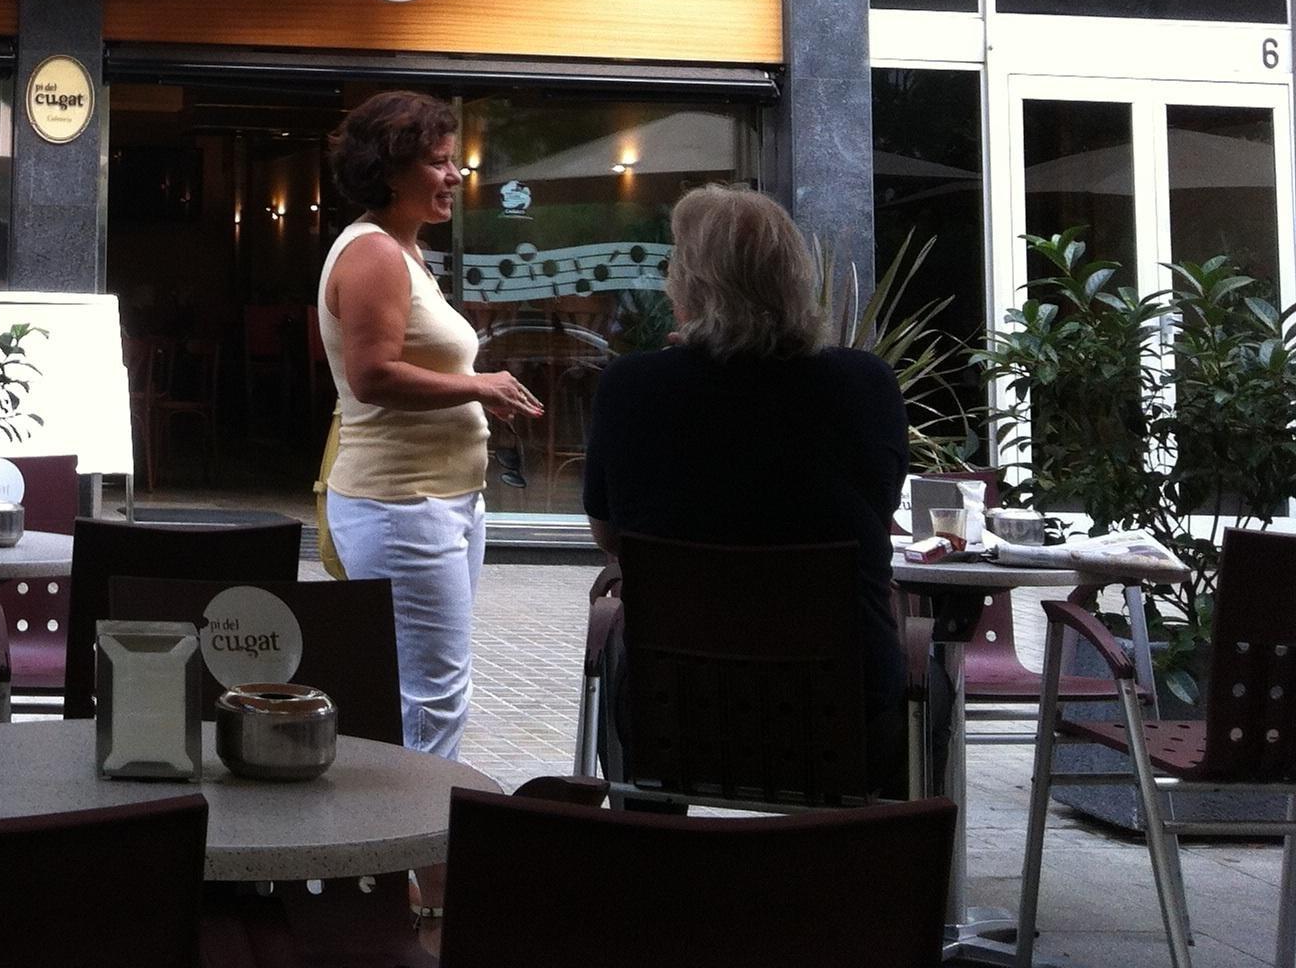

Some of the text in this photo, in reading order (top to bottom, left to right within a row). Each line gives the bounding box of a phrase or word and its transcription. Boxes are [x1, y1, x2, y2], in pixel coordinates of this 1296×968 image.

[1262, 37, 1279, 69] 6
[35, 93, 84, 111] cugat
[210, 619, 240, 632] pi del
[212, 632, 281, 659] cugat
